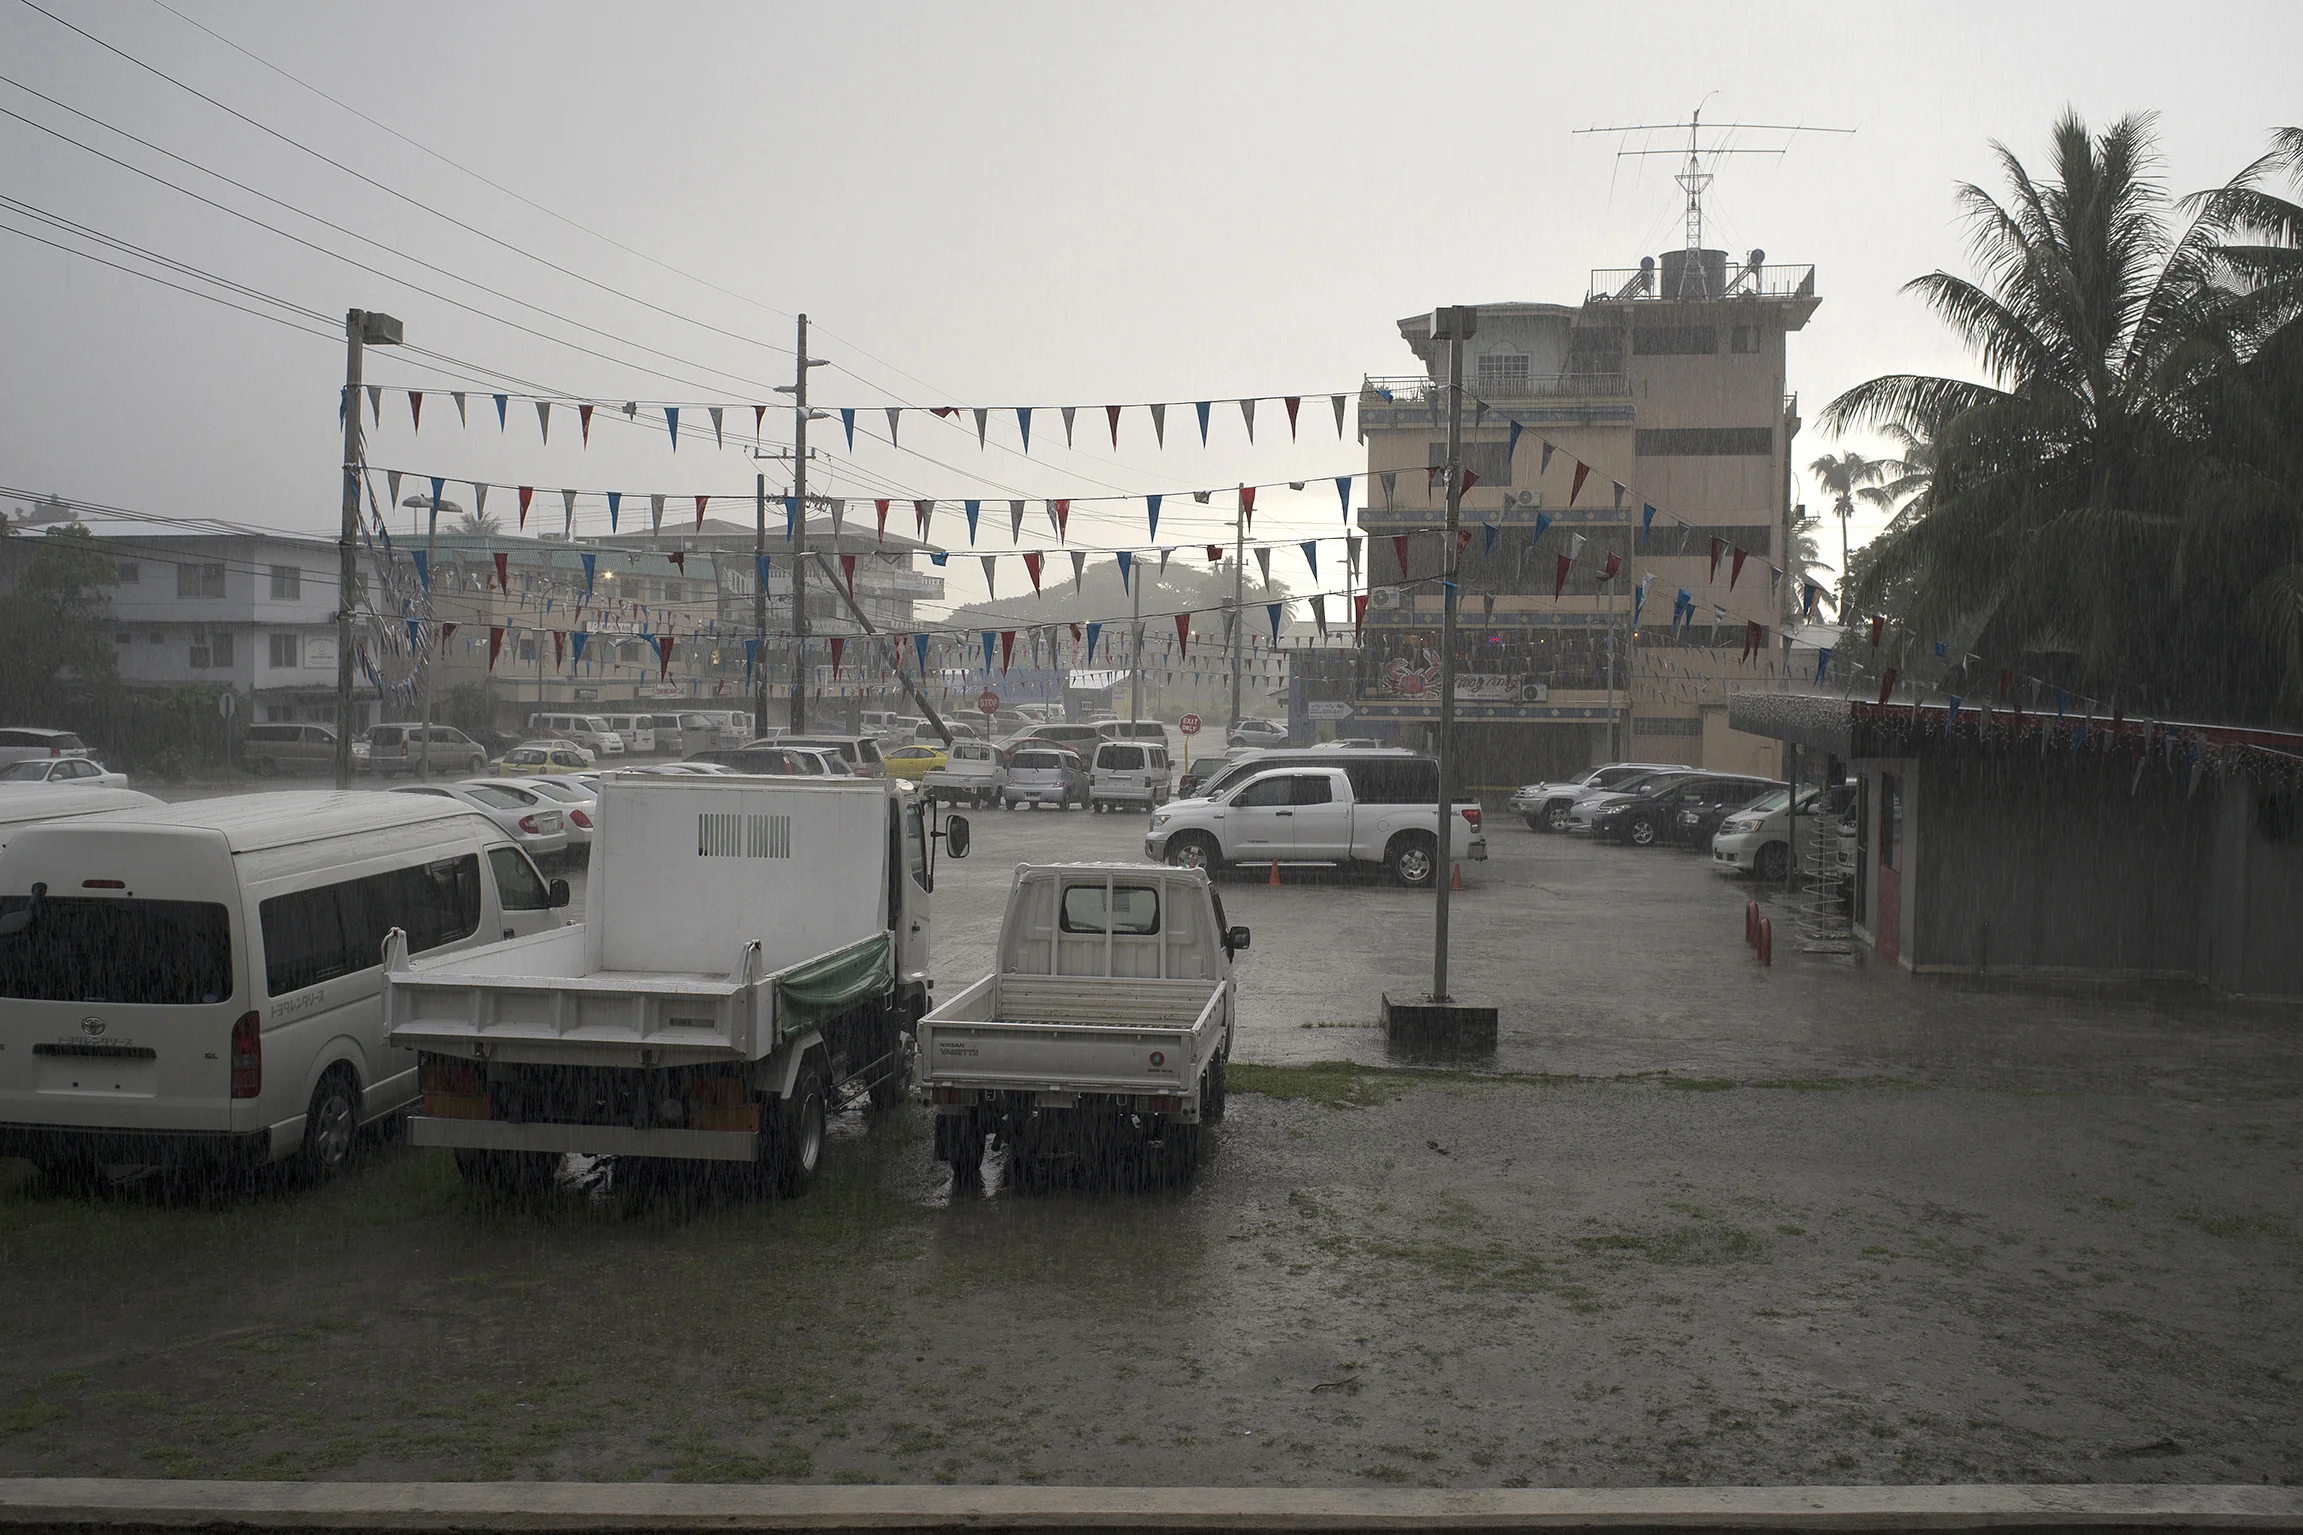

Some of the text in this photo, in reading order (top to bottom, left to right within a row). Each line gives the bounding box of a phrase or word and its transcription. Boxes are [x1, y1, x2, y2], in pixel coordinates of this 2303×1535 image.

[980, 698, 999, 707] STOP
[1183, 717, 1199, 725] EXIT
[1182, 724, 1197, 732] ONLY
[940, 1048, 979, 1056] VANETTE
